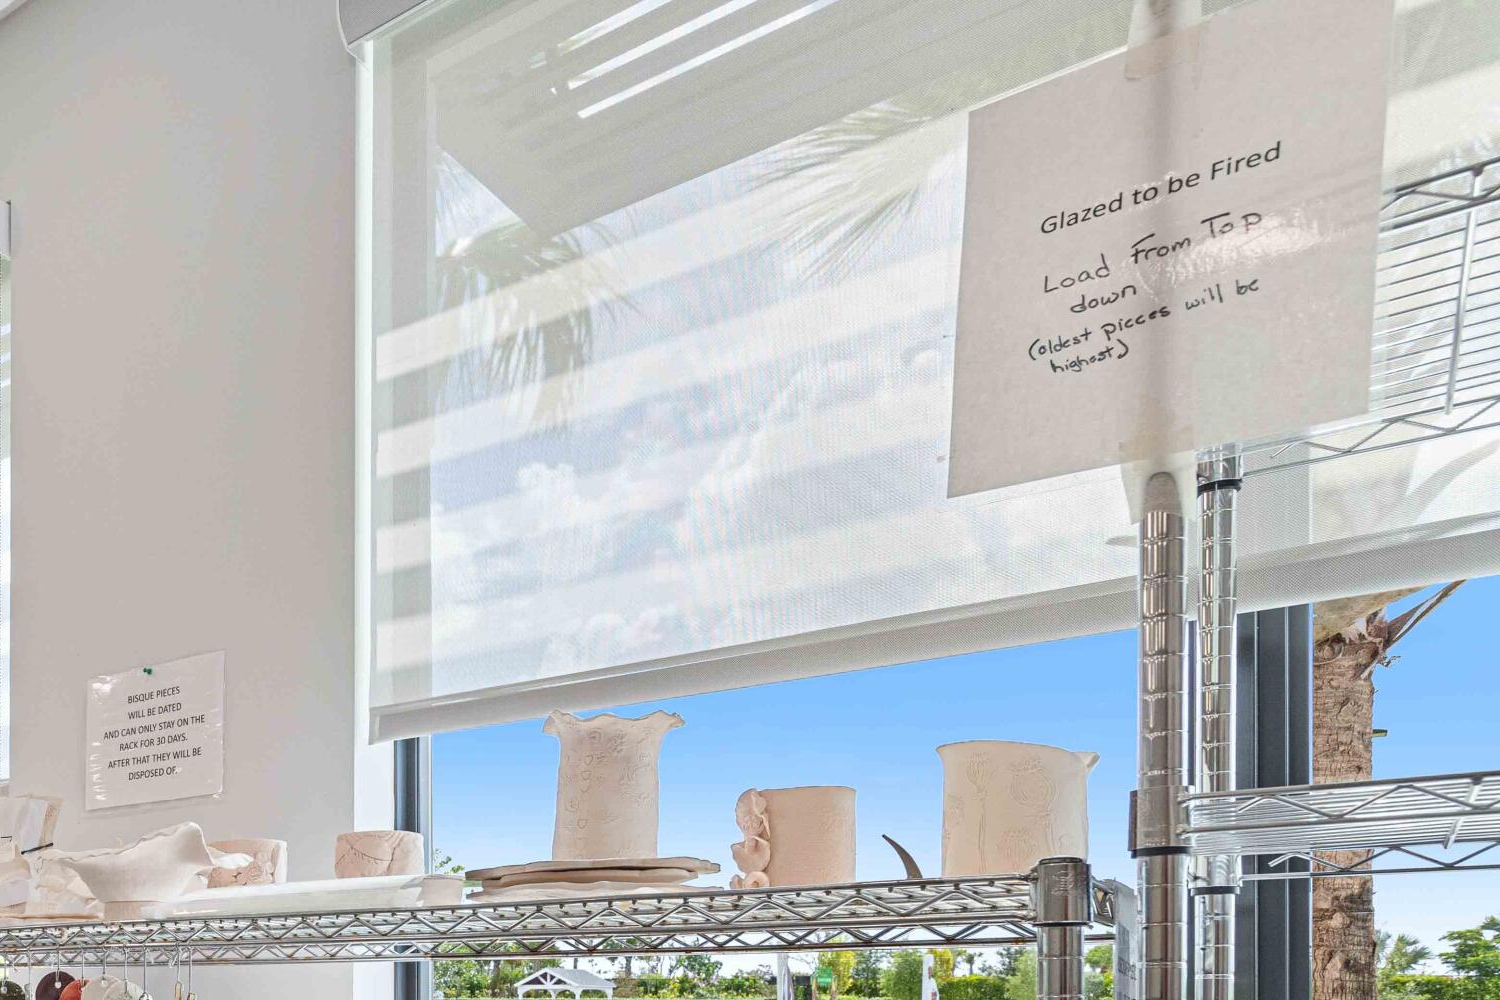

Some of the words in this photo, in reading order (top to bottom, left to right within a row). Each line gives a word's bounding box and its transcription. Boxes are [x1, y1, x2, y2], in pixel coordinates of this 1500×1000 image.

[1040, 192, 1123, 234] Glazed
[1132, 185, 1159, 205] to
[1168, 171, 1201, 195] be
[1210, 141, 1282, 181] Fired
[1043, 253, 1110, 293] Load
[1070, 284, 1137, 313] down
[1028, 328, 1093, 361] (oldest
[1101, 305, 1171, 341] pieces
[1185, 284, 1224, 312] will
[1235, 277, 1259, 296] be
[1050, 338, 1129, 373] highest)
[127, 691, 155, 704] BISQUE
[156, 686, 181, 698] PIECES
[127, 710, 146, 720] WILL
[147, 707, 157, 717] BE
[158, 702, 182, 714] DATED
[103, 730, 120, 740] AND
[121, 727, 137, 737] CAN
[138, 723, 157, 735] ONLY
[158, 720, 176, 731] STAY
[177, 717, 189, 727] ON
[190, 714, 205, 724] THE
[119, 741, 139, 751] RACK
[140, 738, 155, 748] FOR
[156, 736, 166, 746] 30
[167, 732, 188, 744] DAYS.
[108, 757, 131, 769] AFTER
[132, 754, 151, 766] THAT
[152, 751, 171, 763] THEY
[173, 749, 191, 760] WILL
[192, 747, 202, 757] BE
[128, 768, 165, 781] DISPOSED
